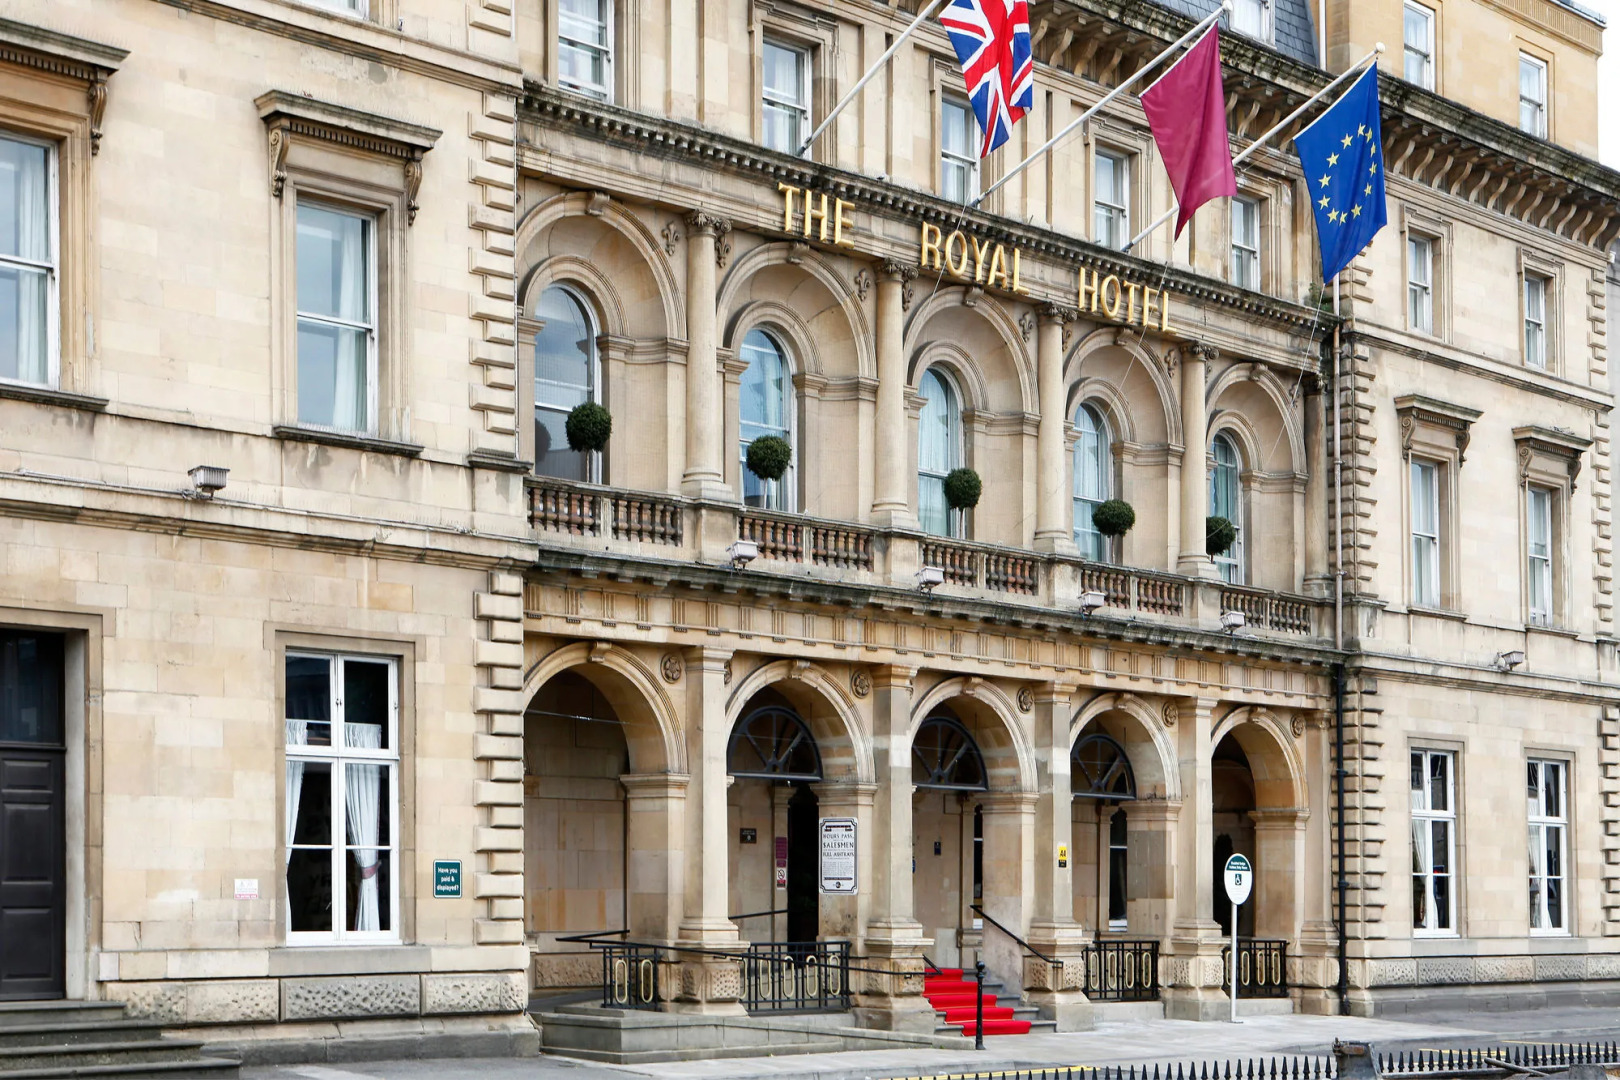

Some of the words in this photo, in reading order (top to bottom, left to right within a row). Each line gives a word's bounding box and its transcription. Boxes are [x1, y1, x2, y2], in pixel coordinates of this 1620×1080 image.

[778, 182, 856, 249] THE
[921, 221, 1030, 296] ROYAL
[1078, 266, 1177, 334] HOTEL
[436, 884, 459, 892] displayed?
